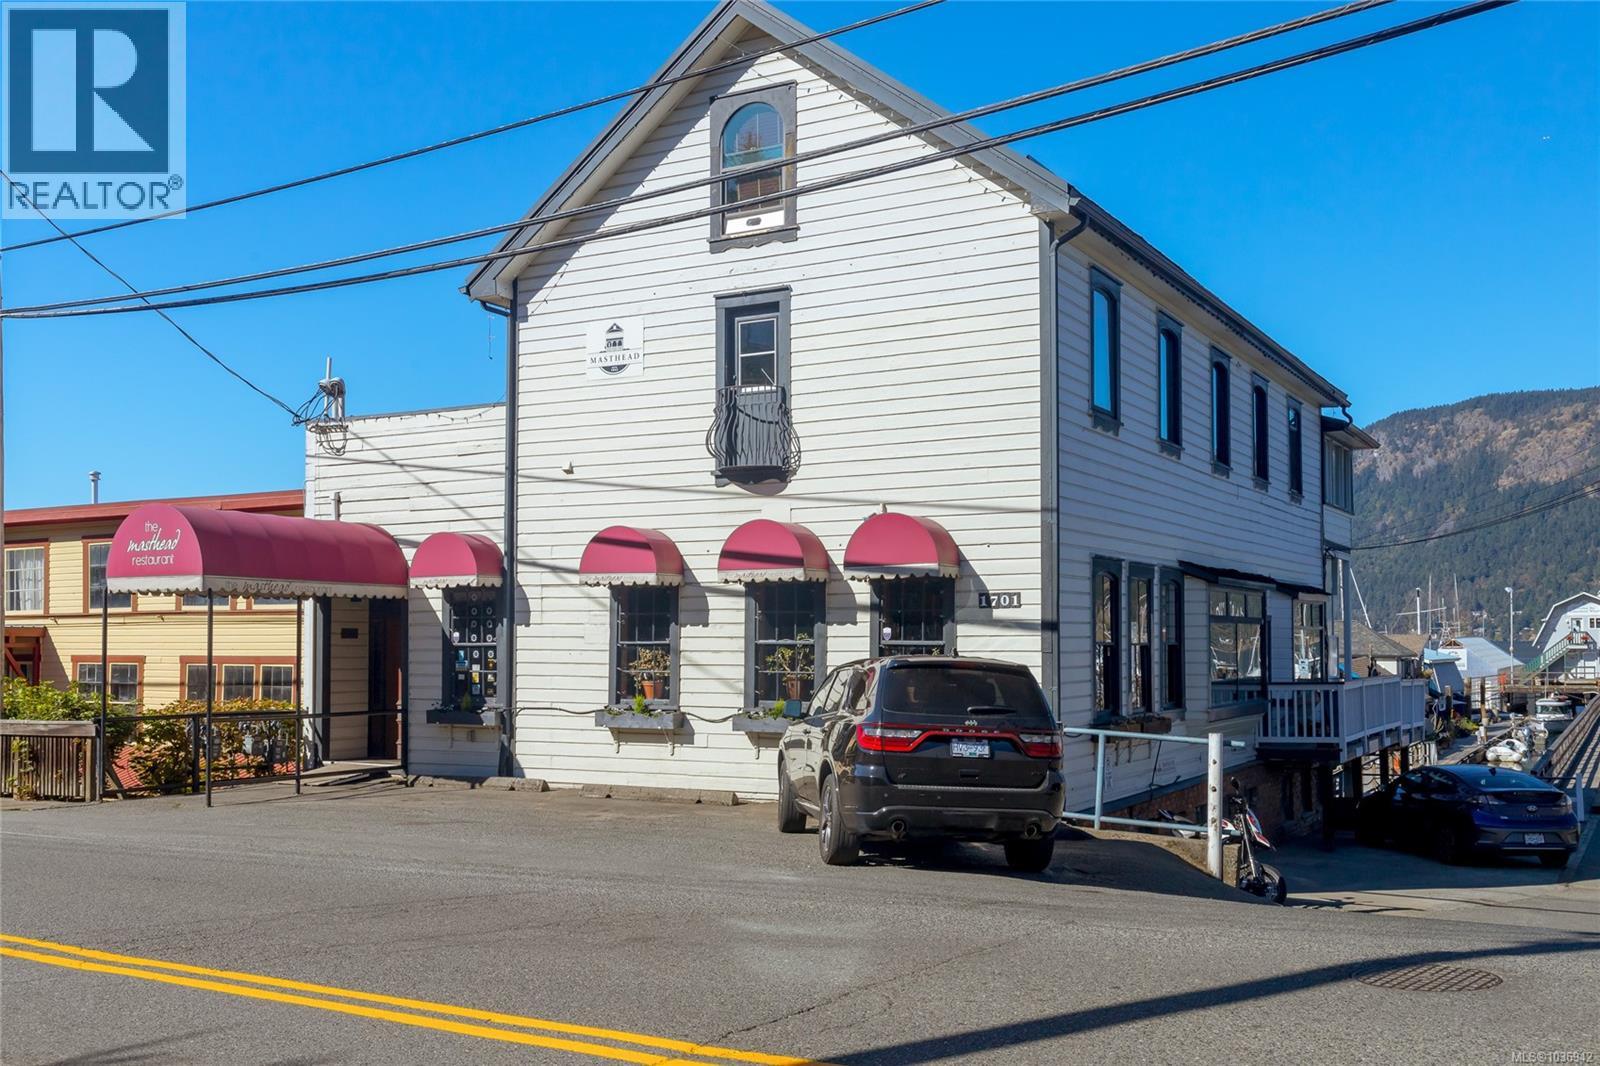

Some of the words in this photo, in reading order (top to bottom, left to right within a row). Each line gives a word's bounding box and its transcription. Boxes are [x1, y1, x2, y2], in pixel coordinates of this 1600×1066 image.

[590, 352, 640, 364] MASTHEAD
[145, 521, 159, 532] the
[127, 528, 180, 552] masthead
[131, 553, 174, 566] restaurant
[980, 595, 1019, 607] 1701
